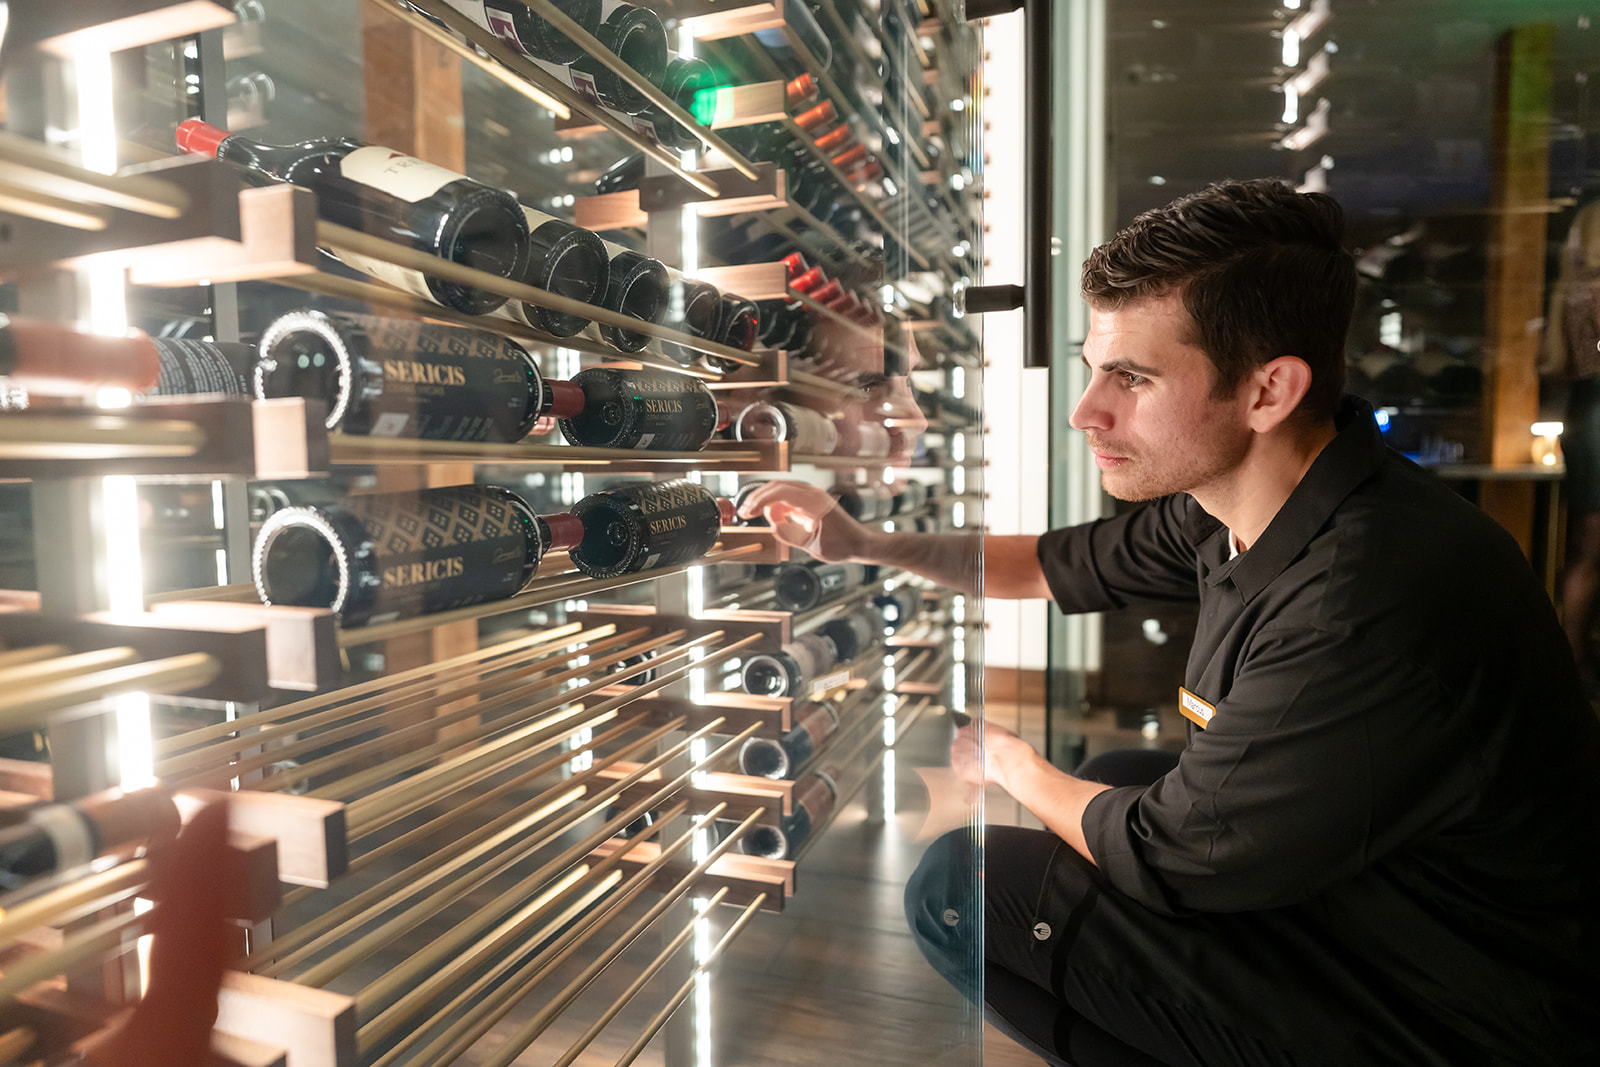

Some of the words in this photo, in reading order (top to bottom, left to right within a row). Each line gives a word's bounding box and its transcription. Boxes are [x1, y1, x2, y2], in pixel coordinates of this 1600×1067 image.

[384, 360, 466, 386] SERICIS
[645, 399, 682, 413] SERICIS
[650, 516, 687, 534] SERICIS
[383, 557, 464, 590] SERICIS
